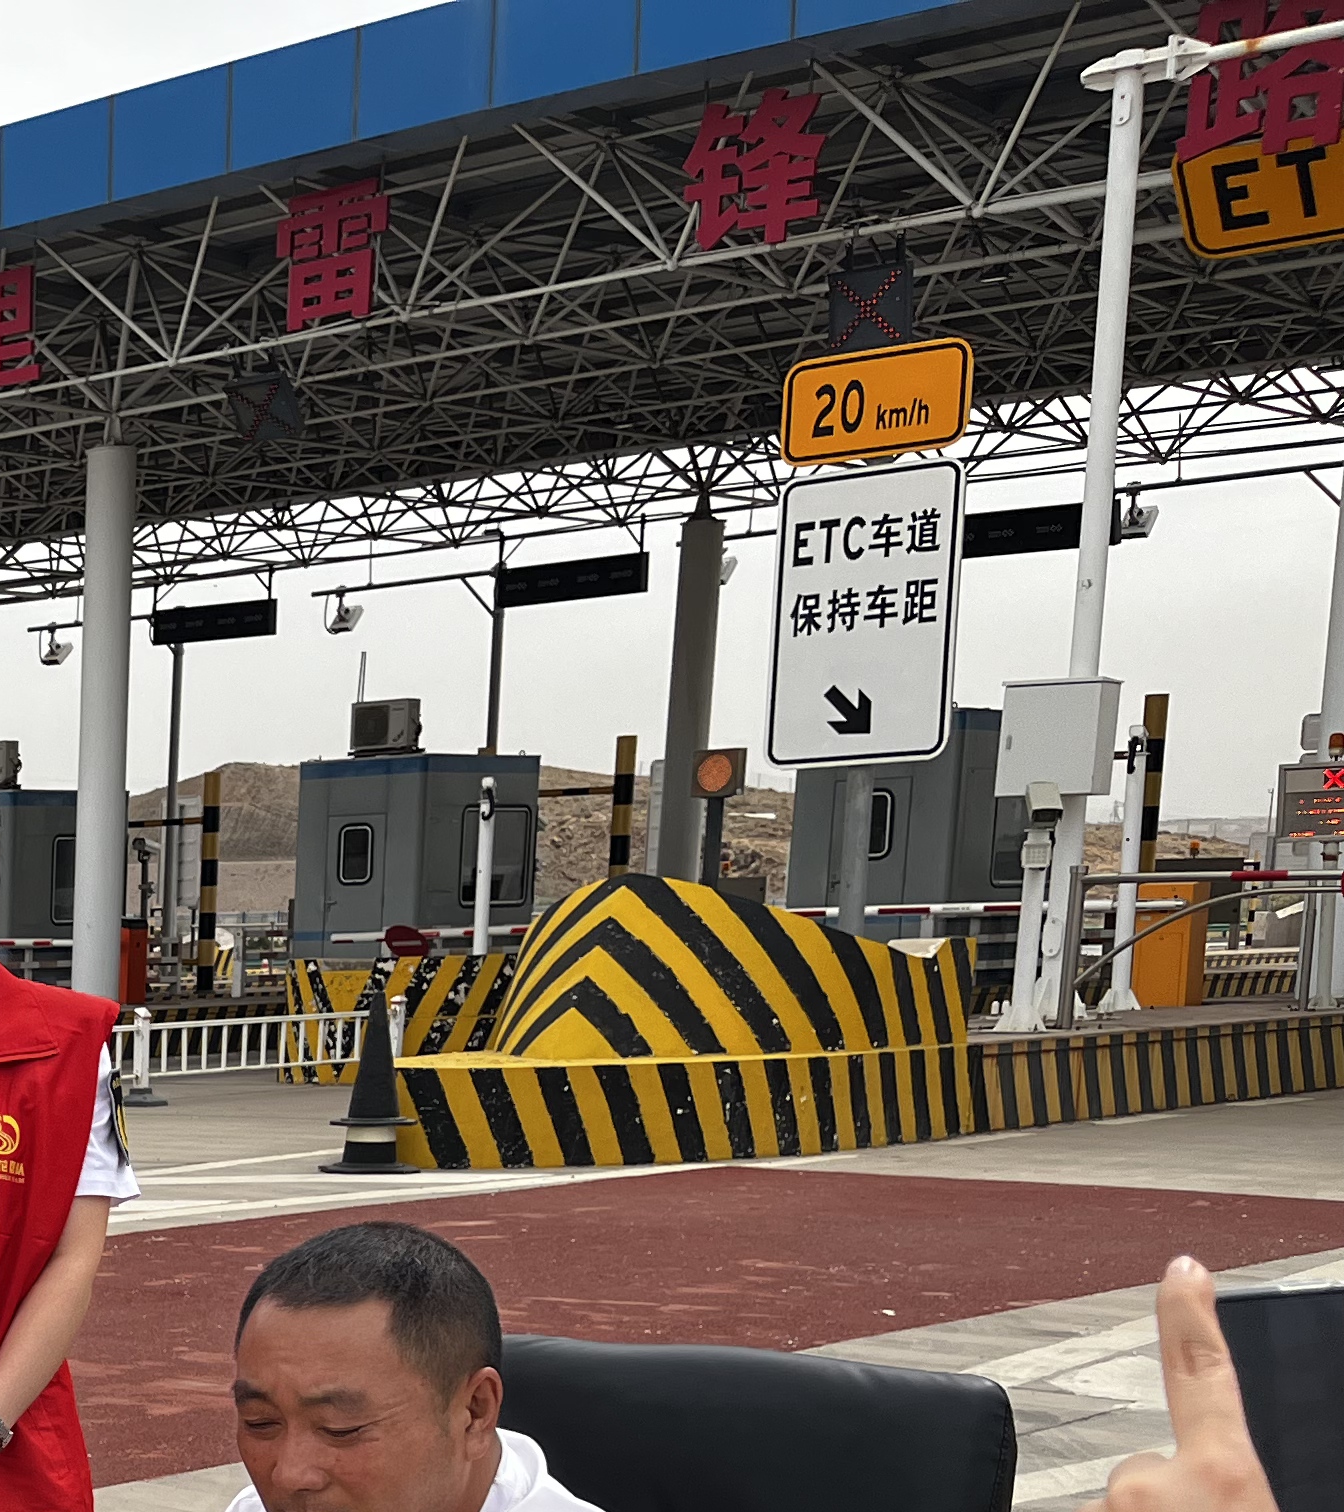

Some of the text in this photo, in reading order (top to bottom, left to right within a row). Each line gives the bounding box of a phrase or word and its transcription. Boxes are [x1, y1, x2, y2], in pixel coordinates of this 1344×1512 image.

[812, 379, 930, 439] 20 km/h
[792, 507, 941, 568] ETC车道
[790, 578, 939, 637] 保持车距
